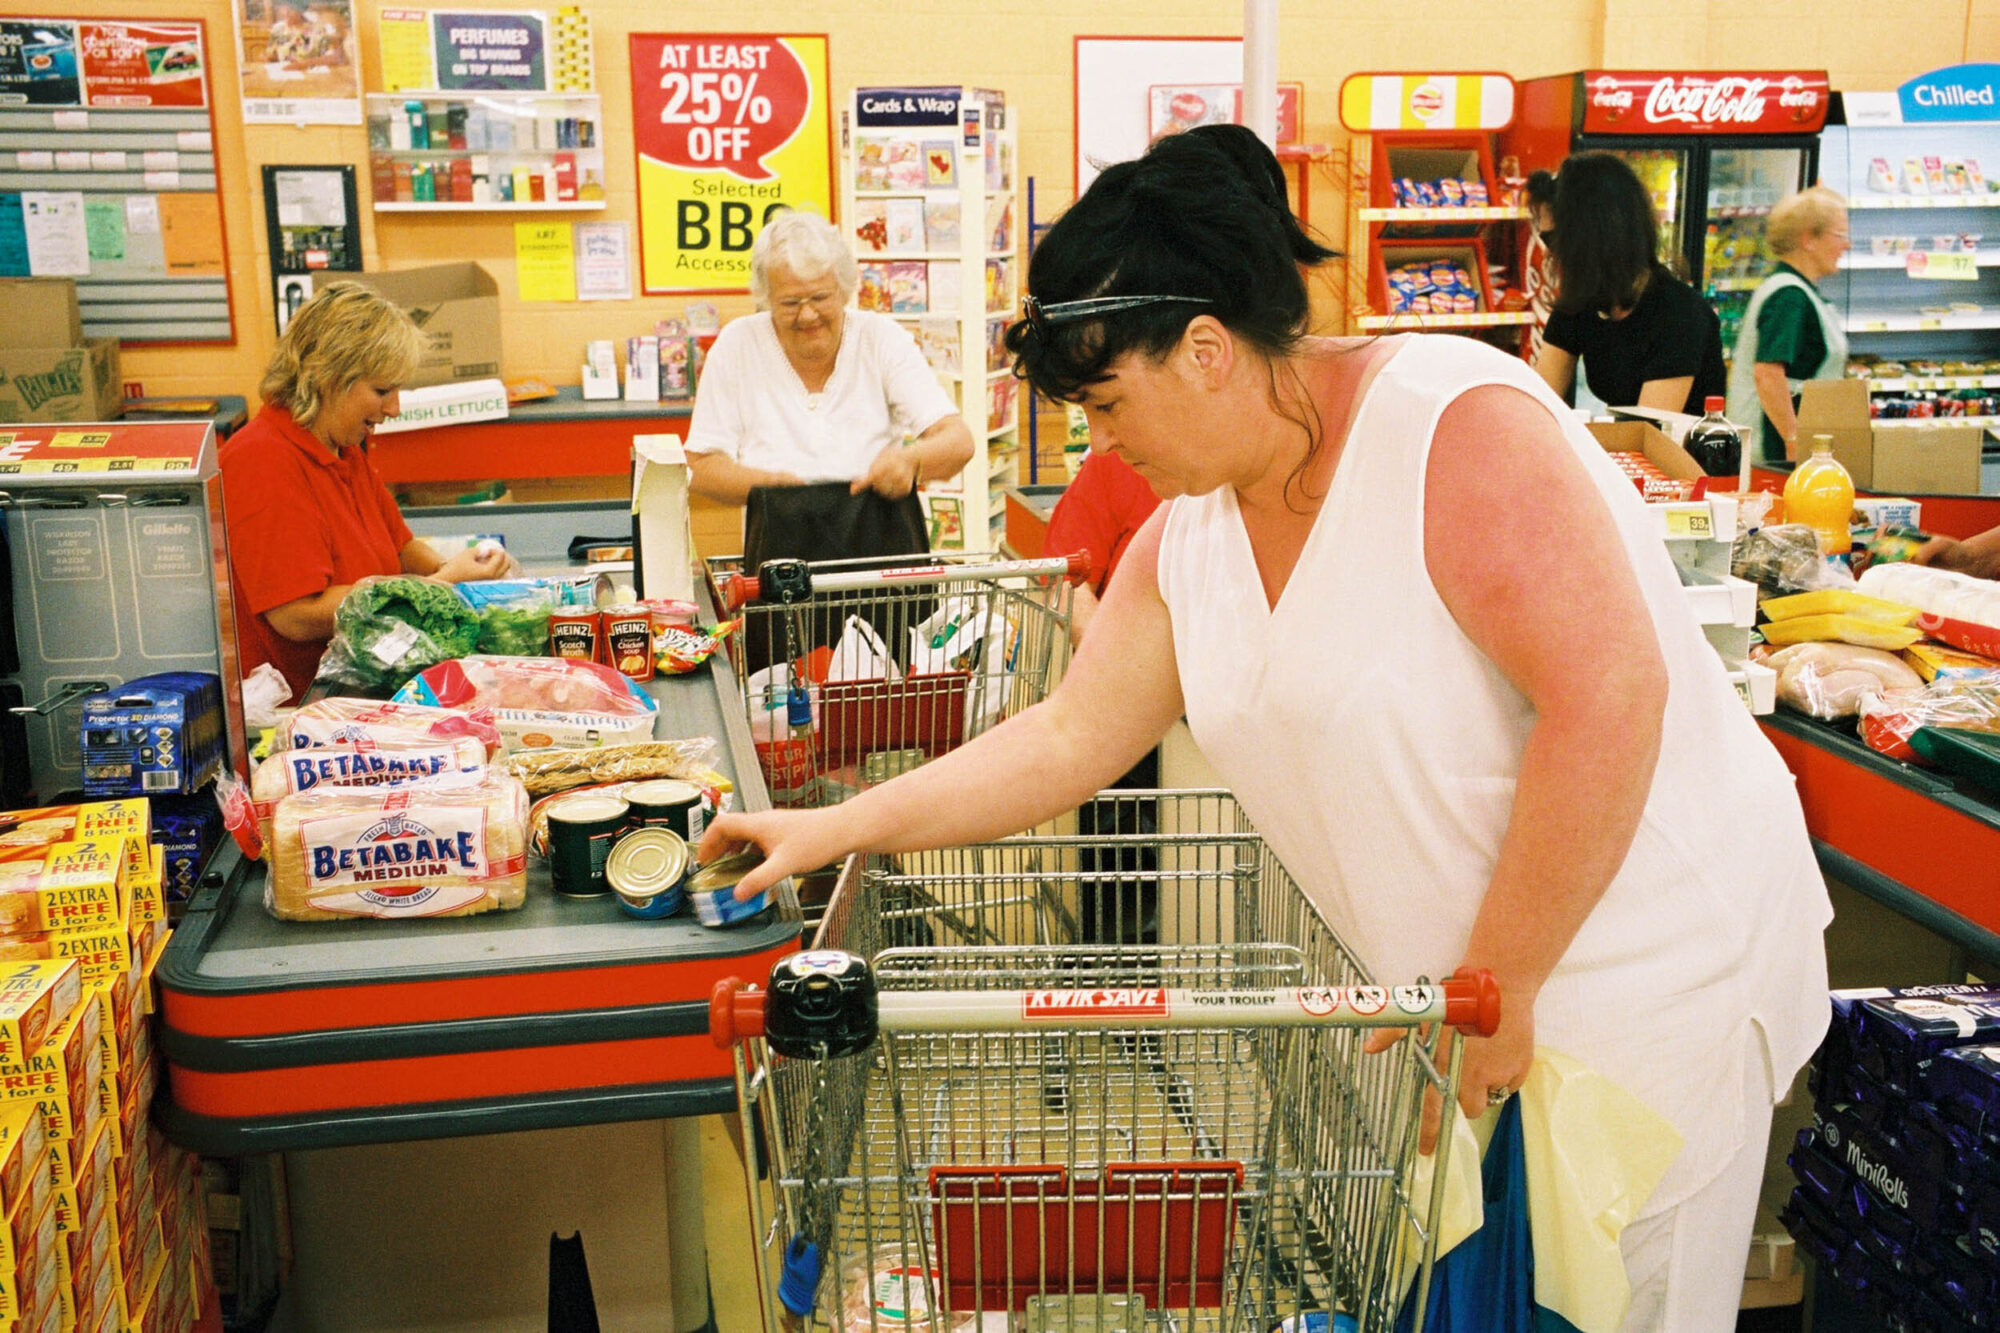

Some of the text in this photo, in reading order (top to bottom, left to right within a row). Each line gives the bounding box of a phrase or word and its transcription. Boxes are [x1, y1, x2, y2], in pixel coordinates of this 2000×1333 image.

[450, 28, 529, 45] PERFUMES
[660, 45, 771, 69] AT LEAST
[660, 72, 772, 125] 25%
[1644, 77, 1769, 123] Coca-Cola
[1914, 84, 1994, 106] Chilled
[862, 97, 956, 115] Cards & Wrap
[687, 126, 750, 161] OFF
[692, 178, 782, 198] Selected
[439, 398, 504, 418] LETTUCE
[143, 523, 192, 536] Gillette
[556, 626, 588, 636] HEINZ
[614, 623, 646, 634] HEINZ
[559, 640, 586, 649] Scotch
[143, 713, 179, 721] DIAMOND
[293, 752, 448, 792] BETABAKE
[104, 803, 122, 811] 2
[84, 817, 141, 829] FREE
[85, 810, 139, 821] EXTRA
[74, 843, 97, 854] 2
[313, 831, 478, 879] BETABAKE
[54, 852, 112, 865] EXTRA
[51, 861, 111, 875] FREE
[353, 864, 448, 882] MEDIUM
[46, 887, 109, 907] 2 EXTRA
[48, 901, 111, 918] FREE
[49, 913, 107, 927] 8 for 6
[58, 936, 121, 957] 2 EXTRA
[76, 950, 124, 966] REE
[9, 964, 41, 978] 2
[109, 962, 120, 971] 6
[1030, 987, 1159, 1008] KWIK SAVE
[1193, 996, 1275, 1005] YOUR TROLLEY
[8, 1084, 56, 1098] for 6
[48, 1129, 60, 1138] 6
[1846, 1139, 1909, 1209] MiniRolls
